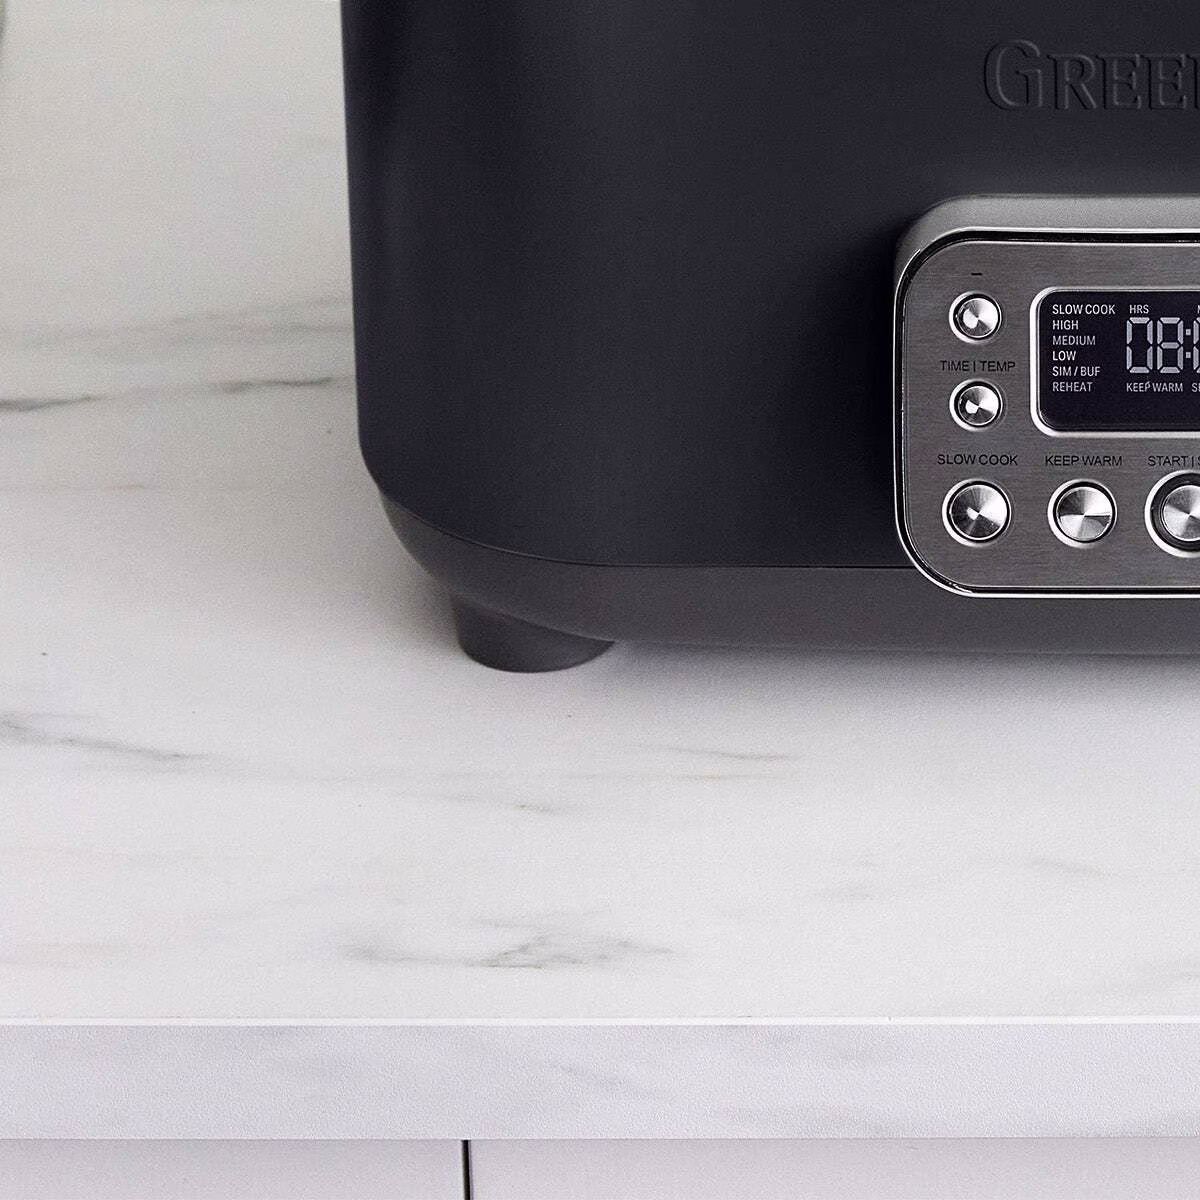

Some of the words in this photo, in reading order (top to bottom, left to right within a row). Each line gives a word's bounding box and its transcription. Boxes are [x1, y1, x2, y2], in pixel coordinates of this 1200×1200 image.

[1052, 304, 1083, 315] SLOW
[1085, 304, 1116, 315] COOK
[1129, 304, 1149, 314] HRS
[1052, 320, 1079, 330] HIGH
[1052, 335, 1096, 346] MEDIUM
[1052, 350, 1077, 361] LOW
[940, 361, 971, 372] TIME
[980, 361, 1016, 372] TEMP
[1052, 366, 1072, 377] SIM
[1080, 366, 1100, 377] BUF
[1052, 381, 1093, 392] REHEAT
[1126, 381, 1150, 393] KEEP
[1152, 382, 1184, 393] WARM
[937, 454, 976, 465] SLOW
[978, 454, 1018, 465] COOK
[1045, 455, 1080, 466] KEEP
[1081, 455, 1123, 466] WARM
[1148, 455, 1189, 466] START
